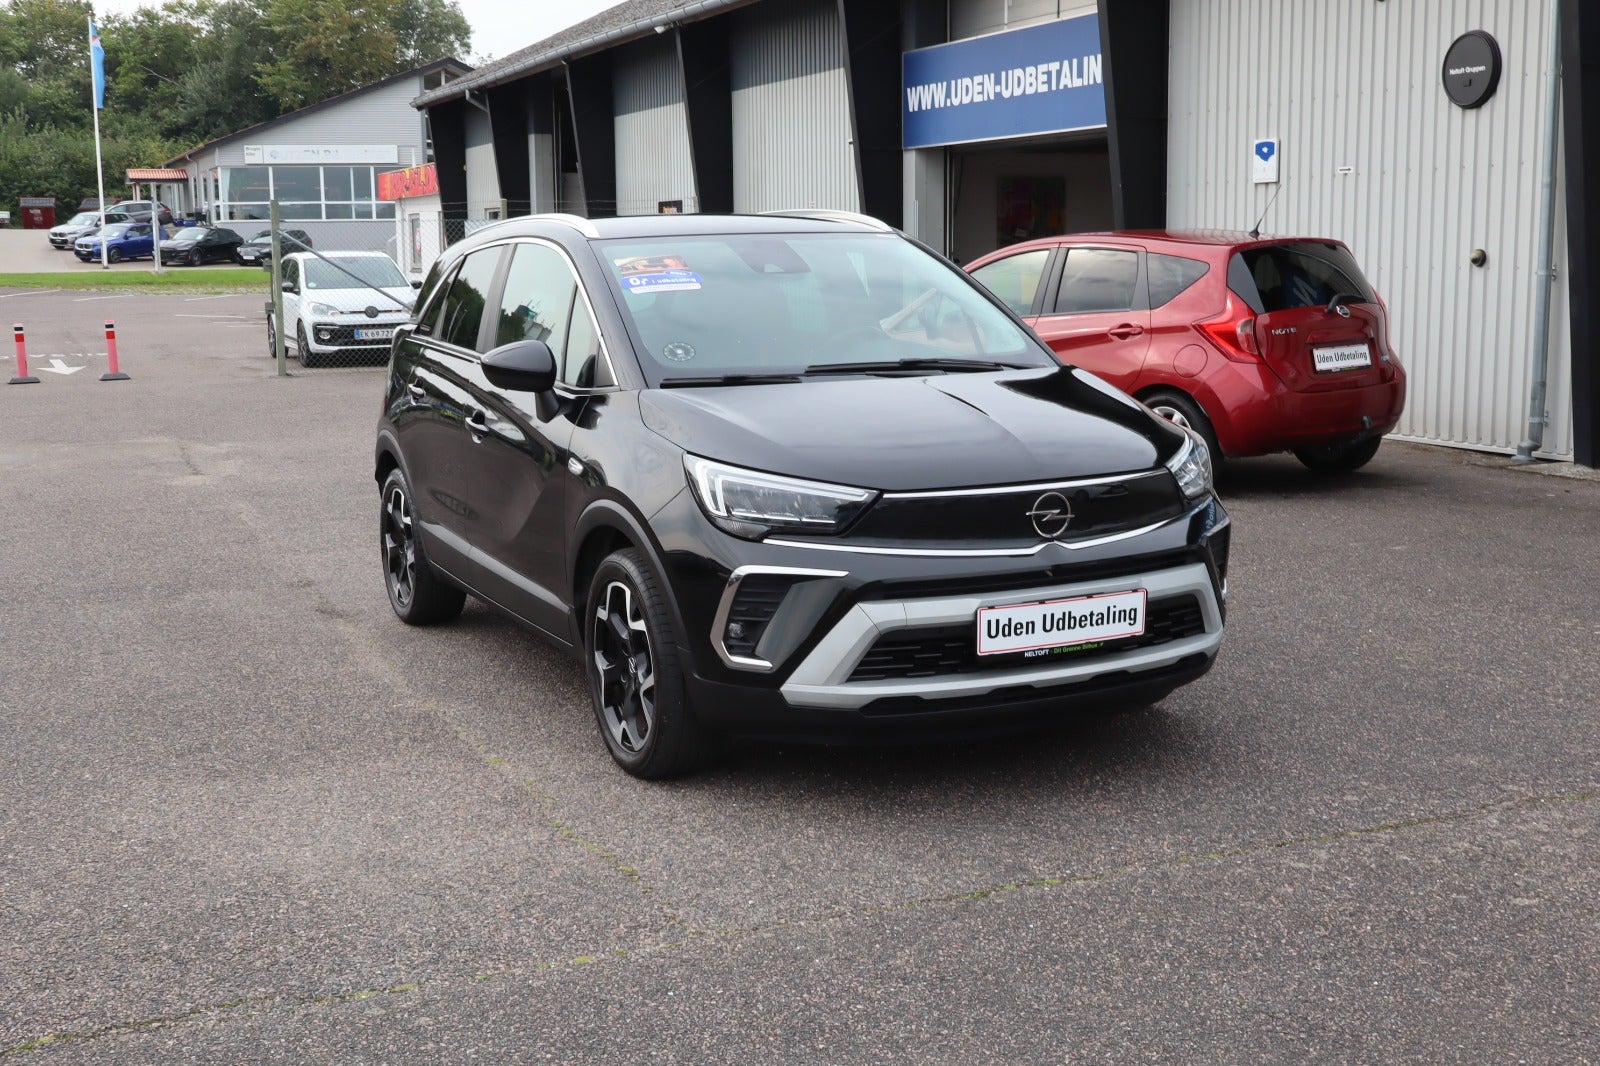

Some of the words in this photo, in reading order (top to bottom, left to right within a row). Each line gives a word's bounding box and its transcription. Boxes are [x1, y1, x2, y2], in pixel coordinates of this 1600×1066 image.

[907, 54, 1102, 112] WWW.UDEN-UDBETALIN
[1316, 353, 1333, 363] Uden
[1334, 350, 1368, 362] Udbetaling
[987, 617, 1035, 638] Uden
[1042, 605, 1138, 633] Udbetaling
